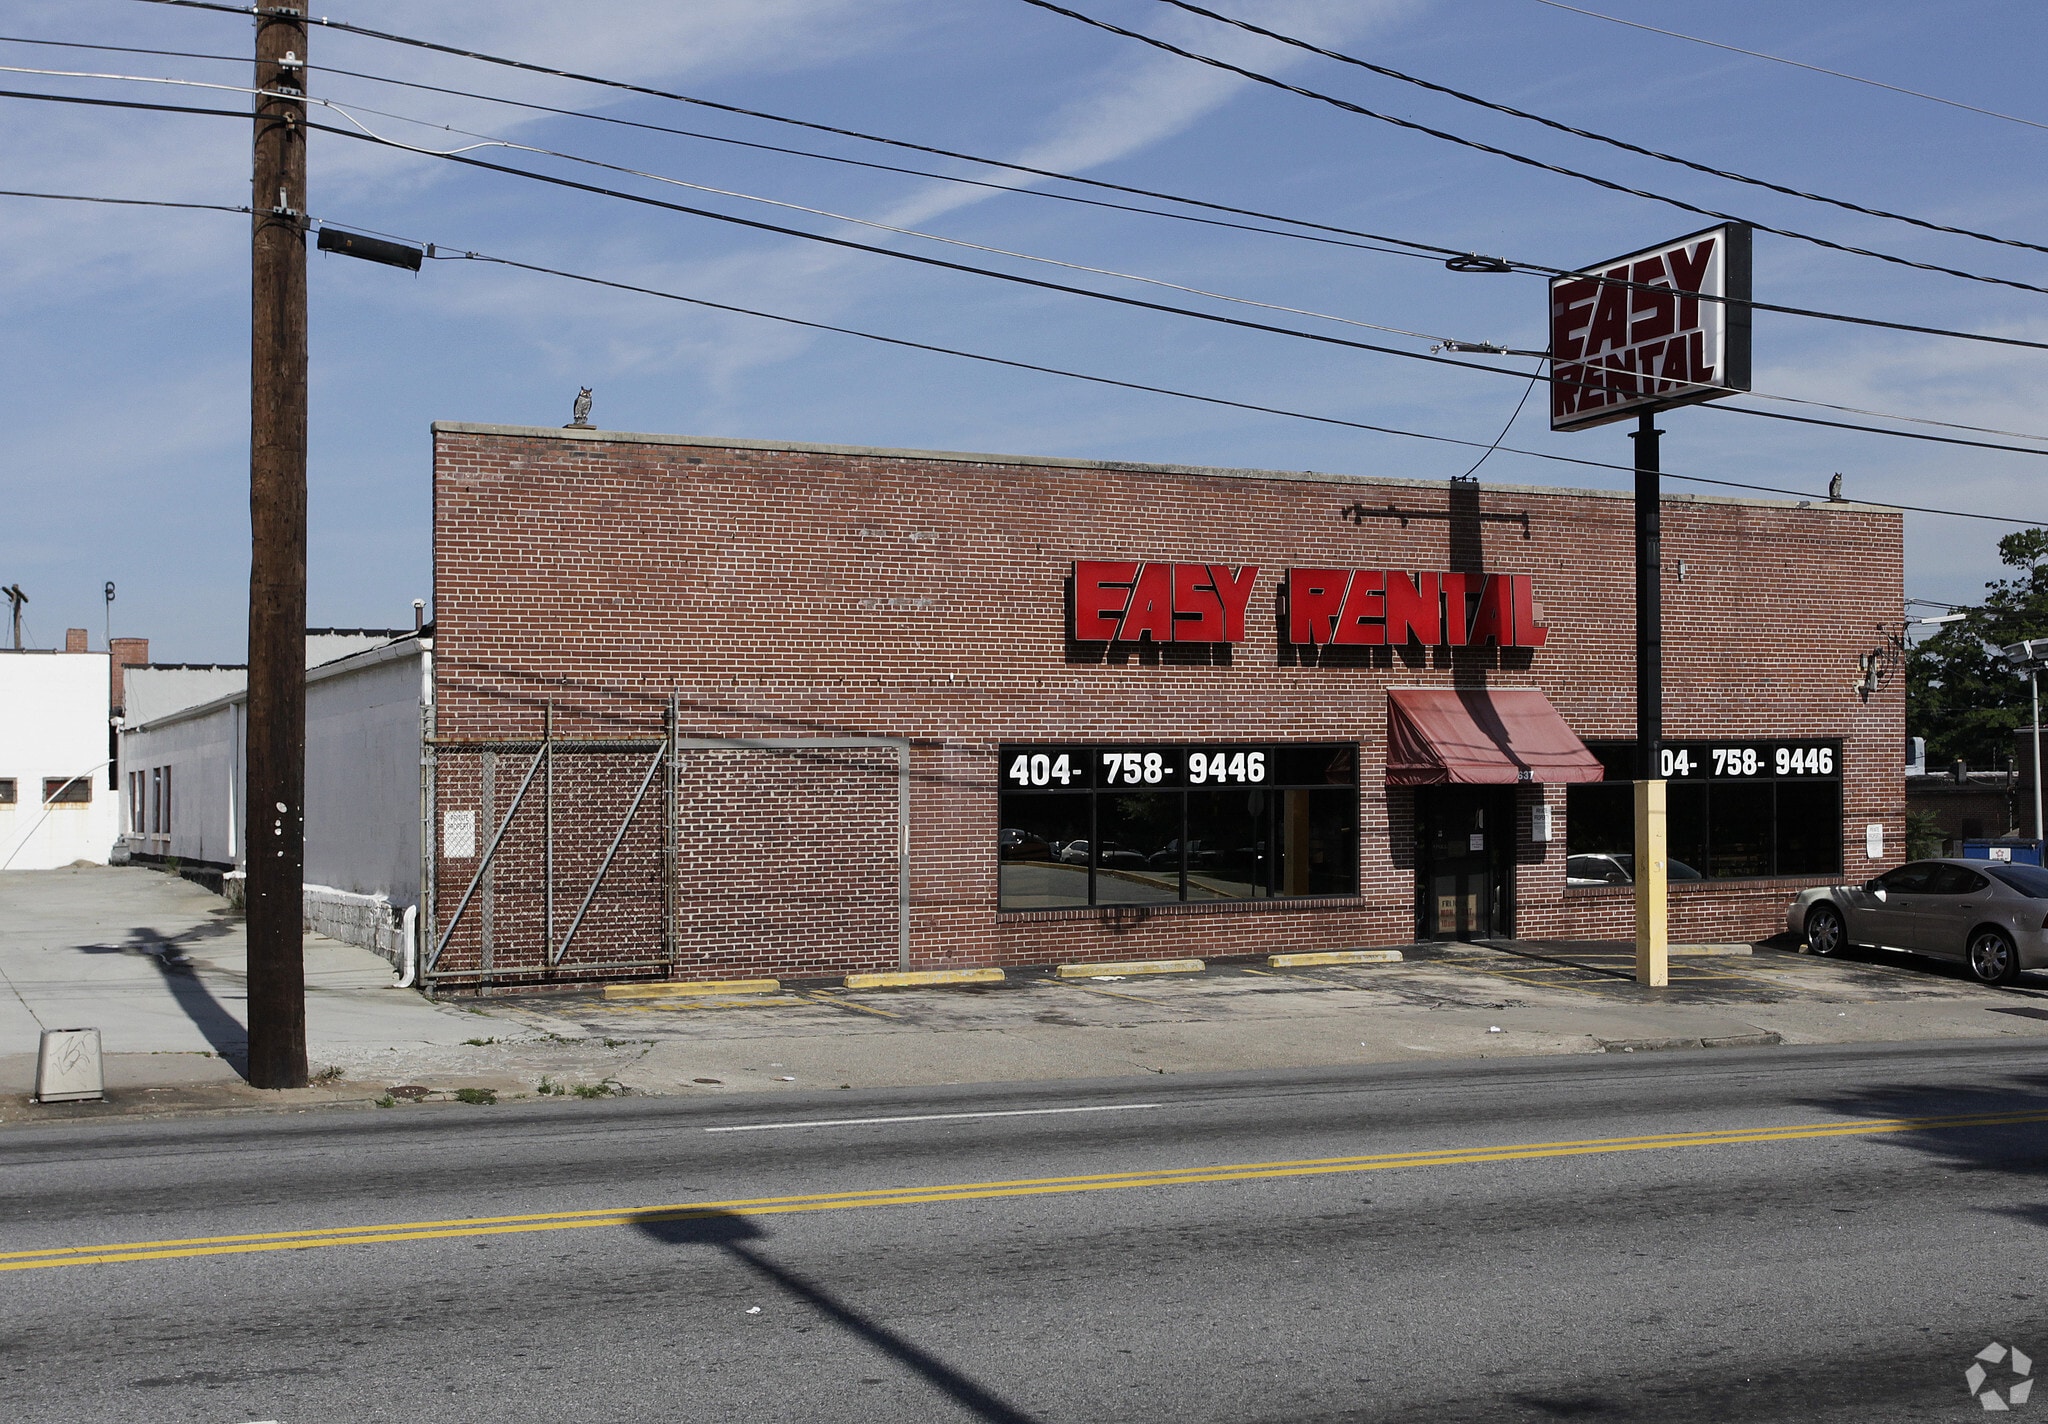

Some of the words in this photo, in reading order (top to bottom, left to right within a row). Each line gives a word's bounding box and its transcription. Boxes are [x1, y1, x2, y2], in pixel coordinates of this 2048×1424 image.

[1553, 237, 1716, 366] EASY
[1553, 330, 1715, 418] RENTAL
[1074, 560, 1260, 643] EASY
[1289, 567, 1550, 647] RENTAL
[1009, 753, 1083, 786] 404-
[1103, 752, 1174, 784] 758-
[1188, 751, 1266, 783] 9446
[1660, 749, 1697, 777] 04-
[1712, 748, 1765, 776] 758-
[1775, 747, 1833, 775] 9446
